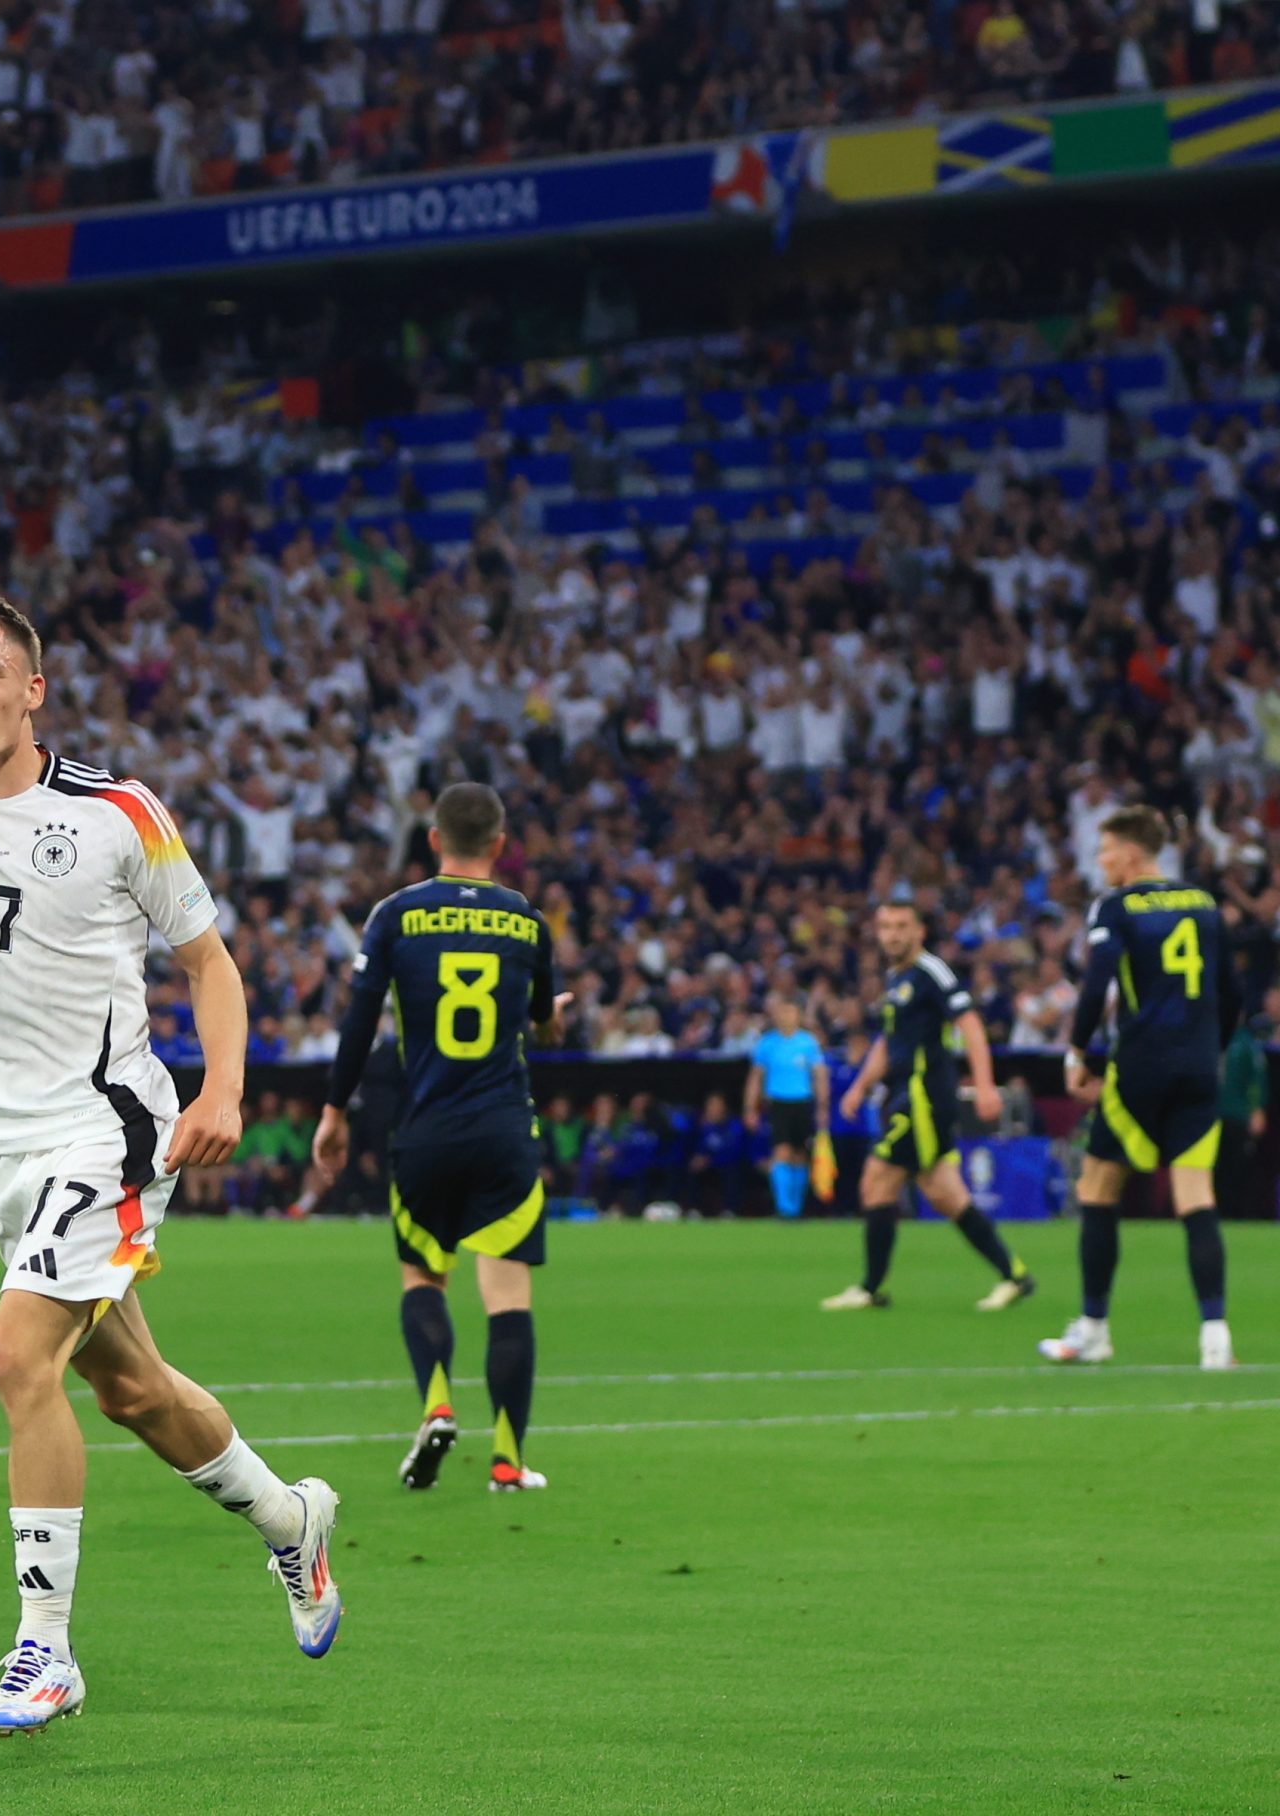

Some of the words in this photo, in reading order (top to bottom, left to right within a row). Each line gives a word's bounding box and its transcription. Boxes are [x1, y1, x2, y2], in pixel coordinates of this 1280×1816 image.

[401, 906, 539, 946] McGREGOR
[1162, 917, 1204, 999] 4
[436, 951, 500, 1060] 8
[25, 1176, 100, 1240] 17
